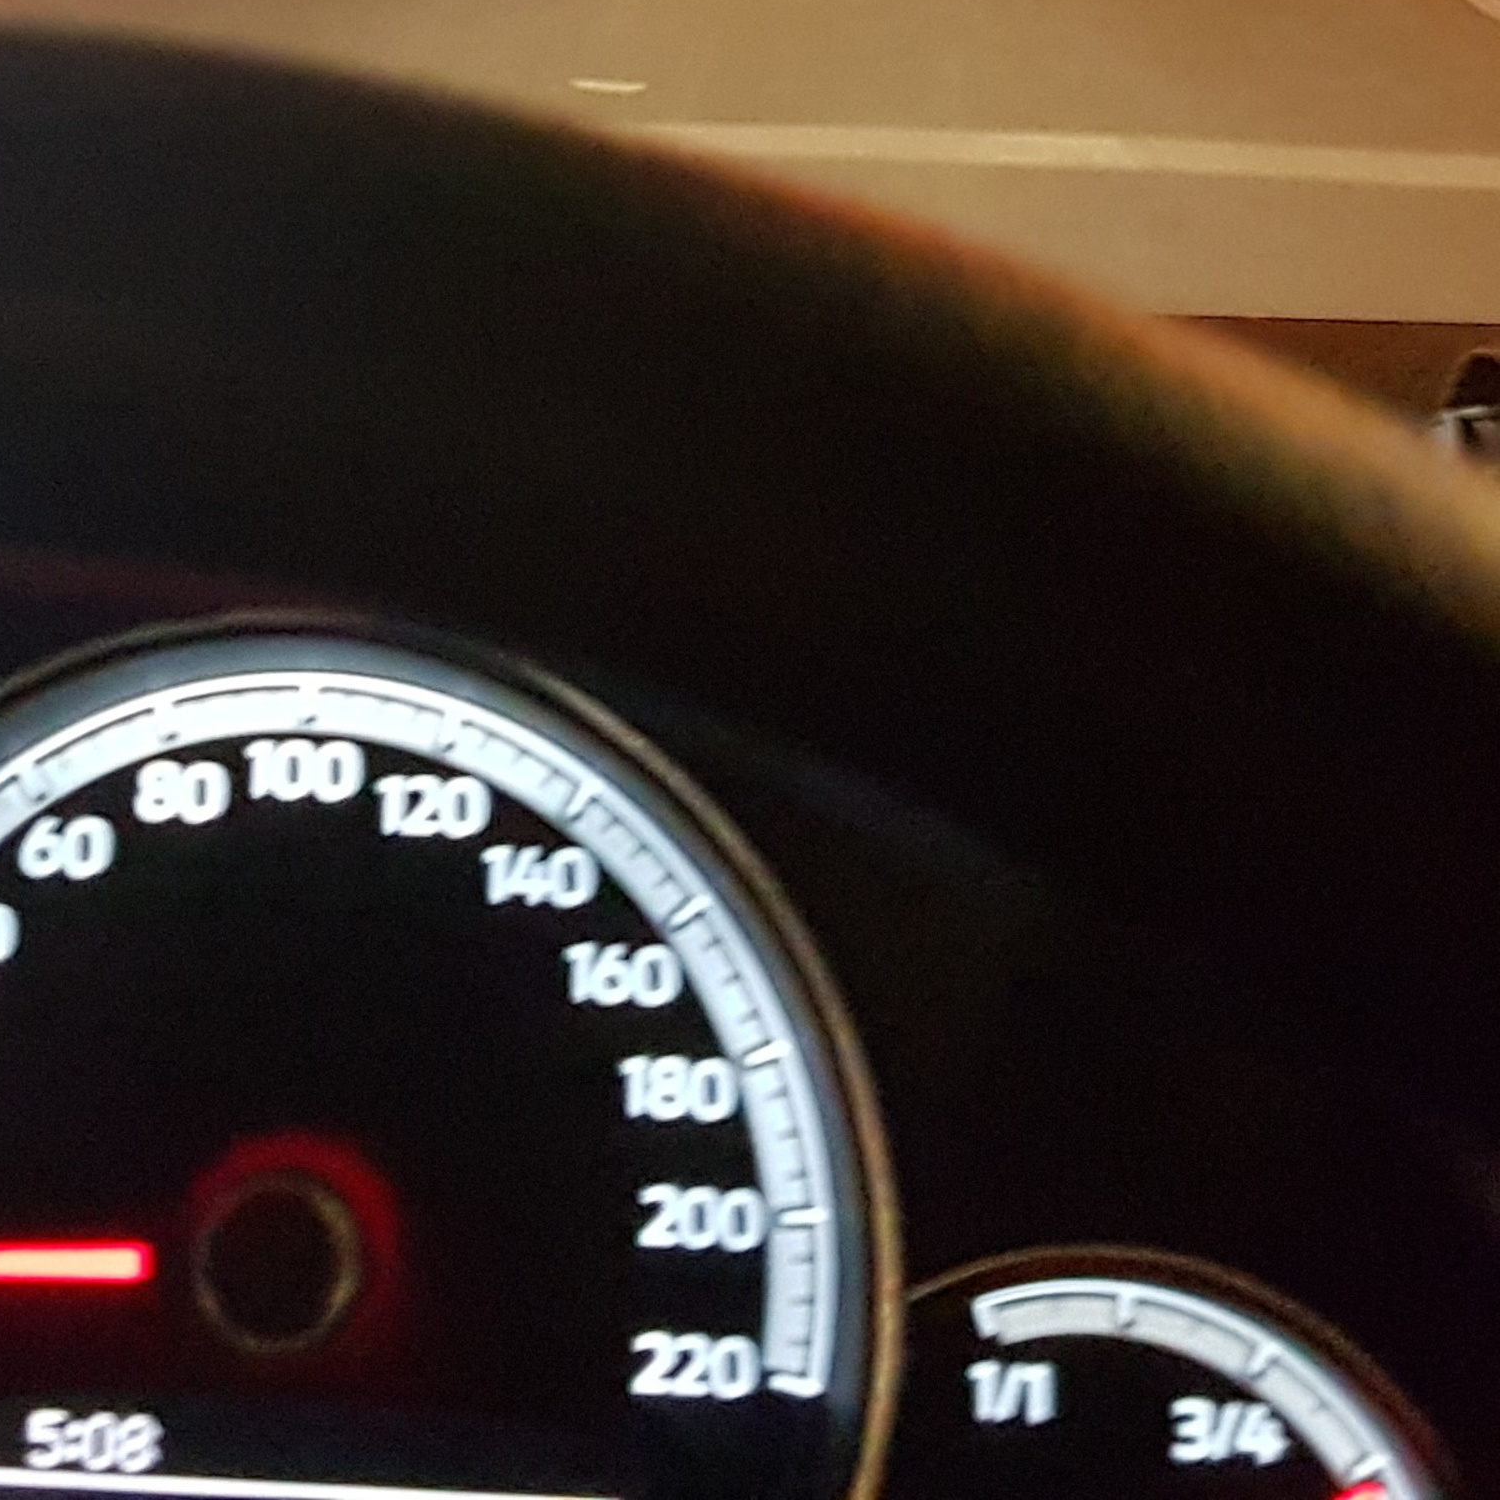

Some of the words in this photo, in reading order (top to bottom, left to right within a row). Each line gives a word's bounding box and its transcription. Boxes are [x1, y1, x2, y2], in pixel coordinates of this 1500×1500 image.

[135, 760, 231, 825] 80
[244, 739, 366, 803] 100
[375, 775, 492, 840] 120
[17, 817, 114, 881] 60
[481, 844, 598, 909] 140
[564, 943, 679, 1008] 160
[620, 1056, 735, 1123] 180
[638, 1186, 763, 1253] 200
[630, 1332, 758, 1400] 220
[967, 1359, 1057, 1426] 1/1
[22, 1408, 164, 1474] 5:08
[1167, 1396, 1290, 1467] 3/4
